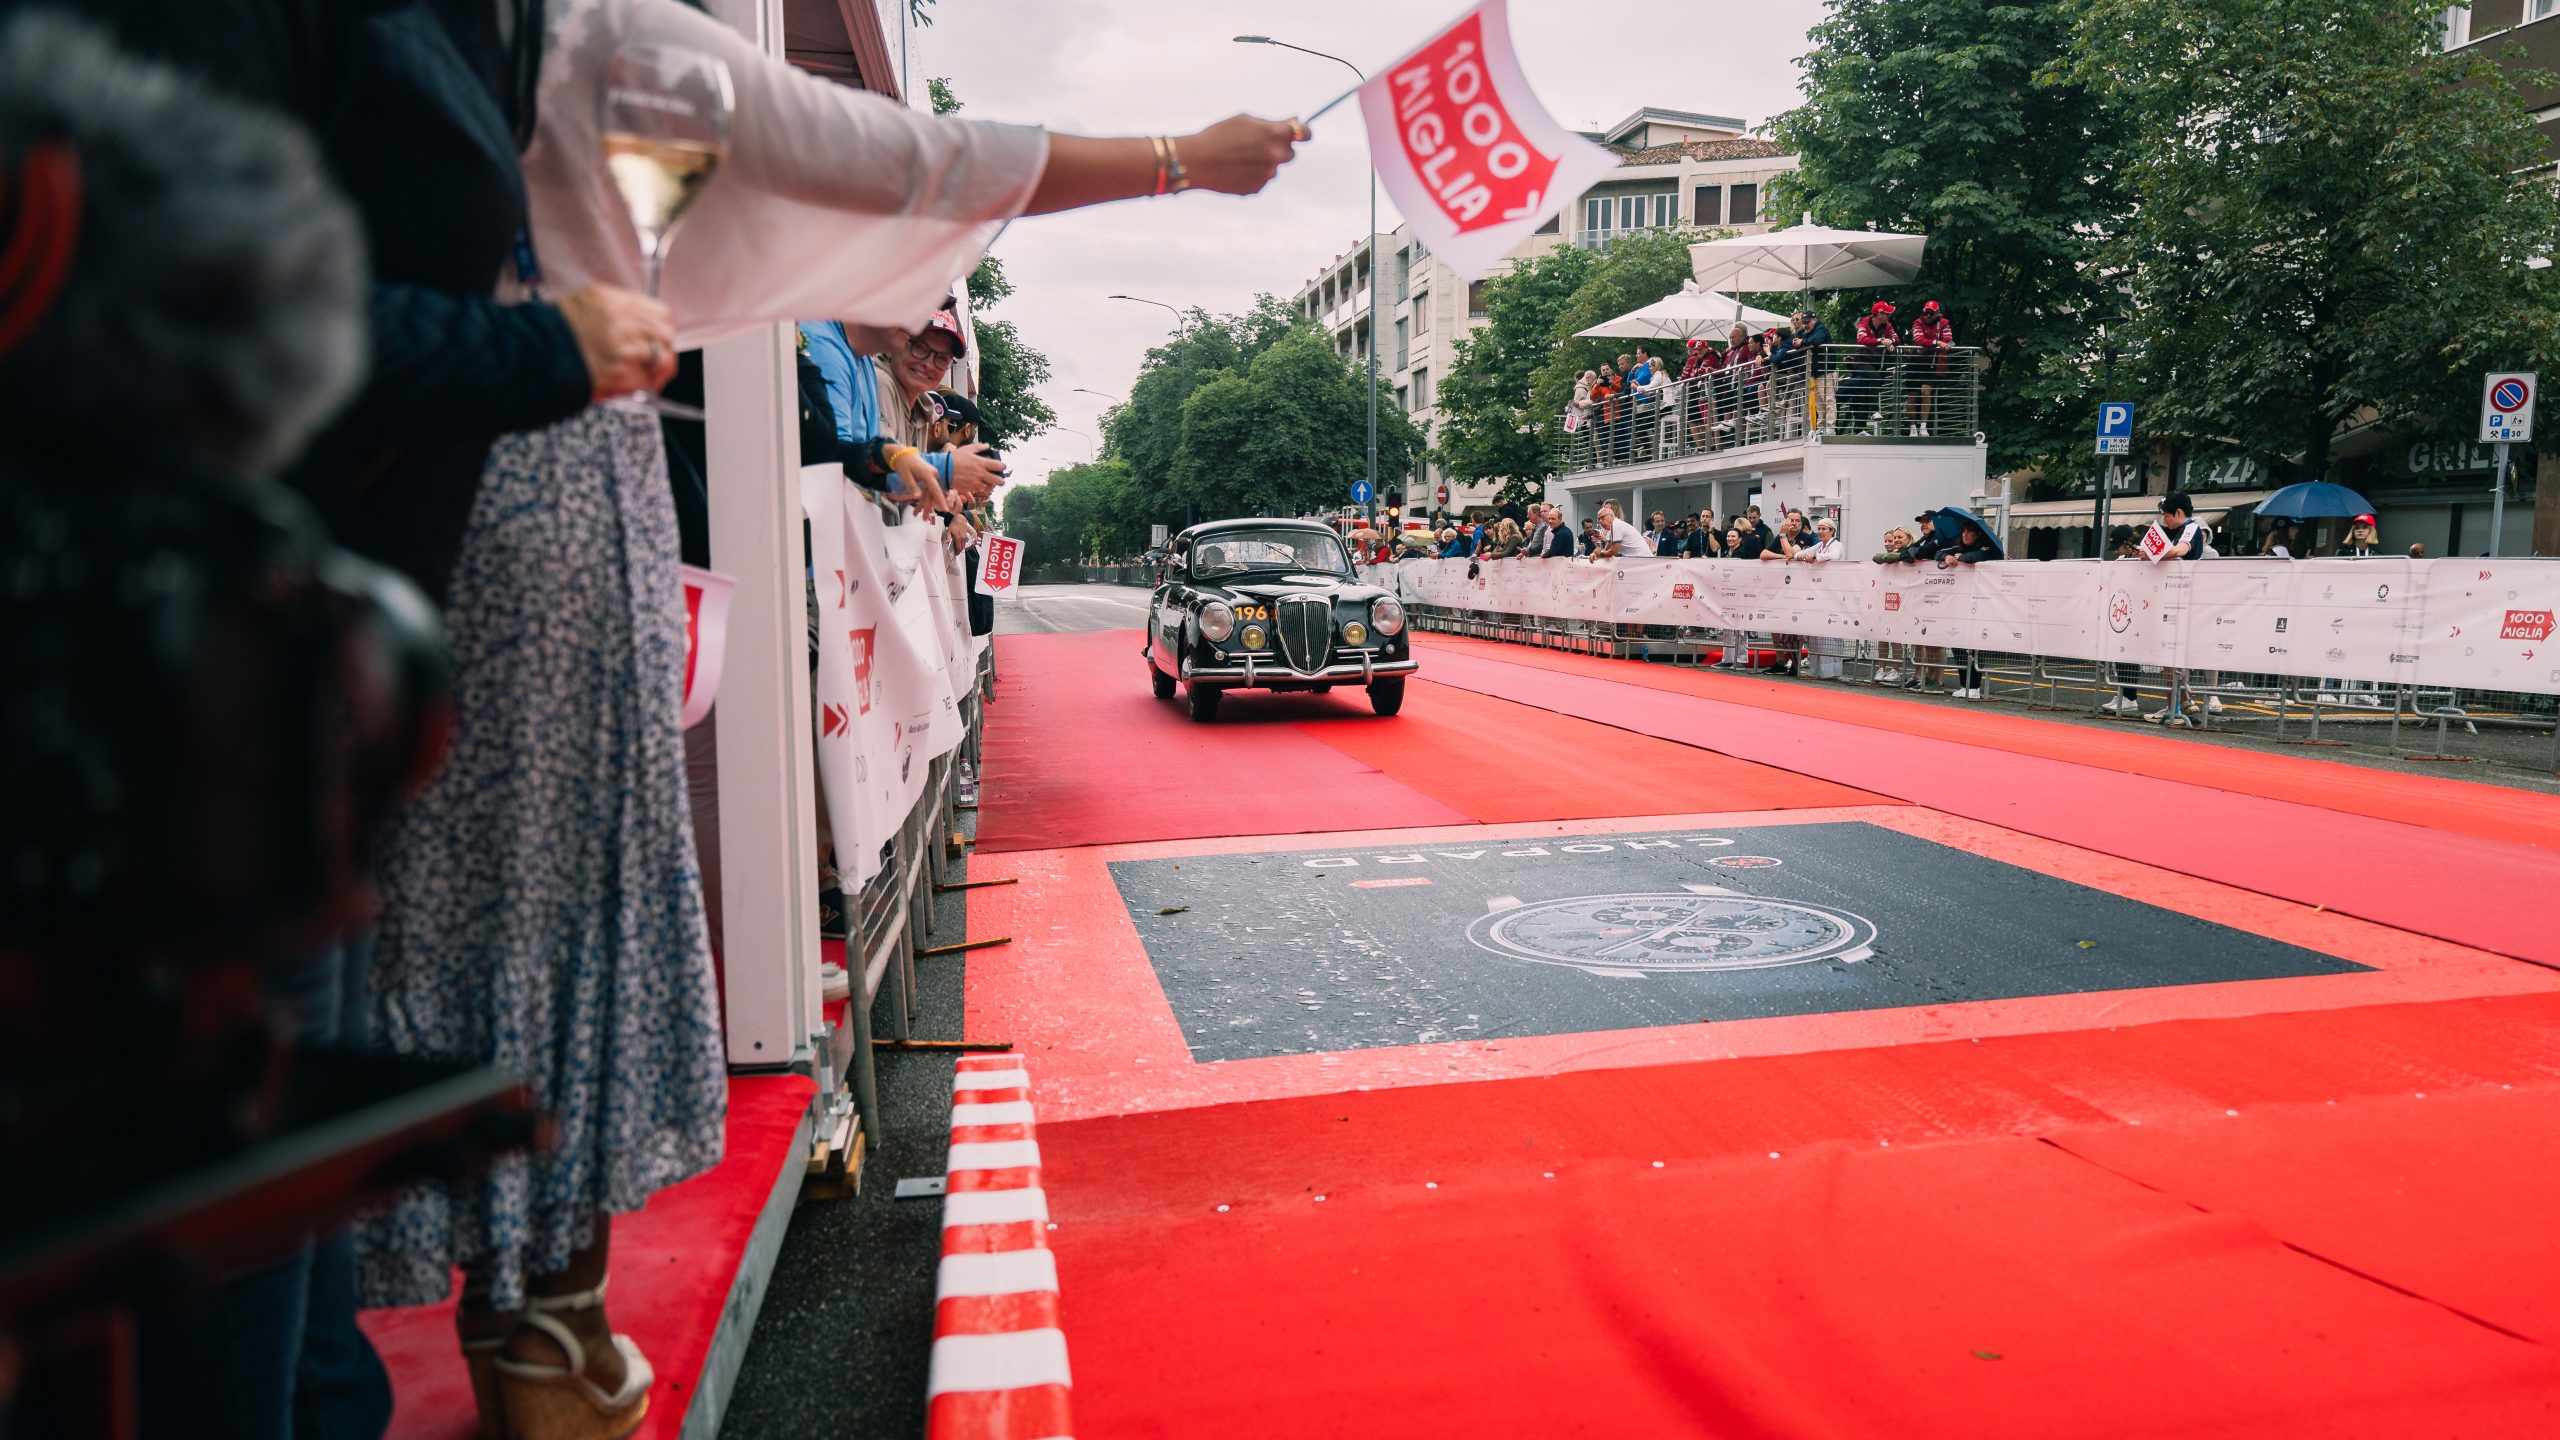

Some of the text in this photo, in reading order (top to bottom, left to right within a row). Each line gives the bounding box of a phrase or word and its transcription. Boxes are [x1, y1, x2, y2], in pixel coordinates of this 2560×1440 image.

[1444, 40, 1530, 181] 1000
[1394, 63, 1492, 222] MIGLIA
[2104, 406, 2127, 434] P
[986, 540, 1002, 580] MIGLIA
[1000, 545, 1014, 581] 1000
[1235, 605, 1268, 621] 196
[2509, 613, 2545, 625] 1000
[2502, 625, 2543, 639] MIGLIA
[1302, 837, 1736, 868] CHOPARD
